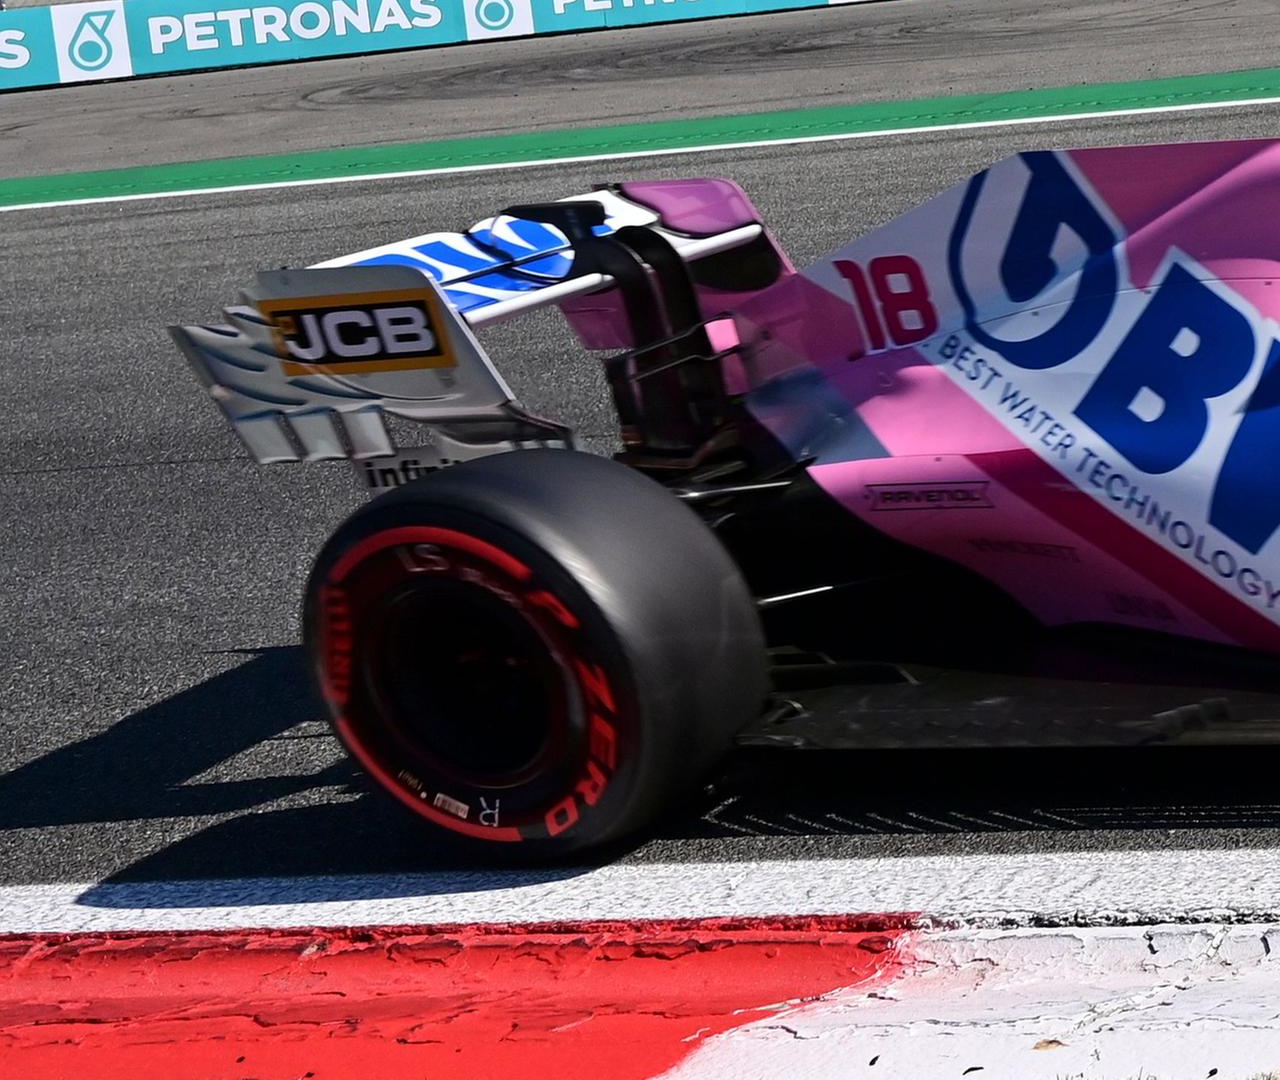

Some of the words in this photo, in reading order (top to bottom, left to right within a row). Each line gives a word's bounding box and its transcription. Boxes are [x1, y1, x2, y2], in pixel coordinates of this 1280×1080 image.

[284, 306, 436, 360] JCB
[832, 255, 938, 351] 18
[938, 334, 1003, 392] BEST
[999, 381, 1077, 460] WATER
